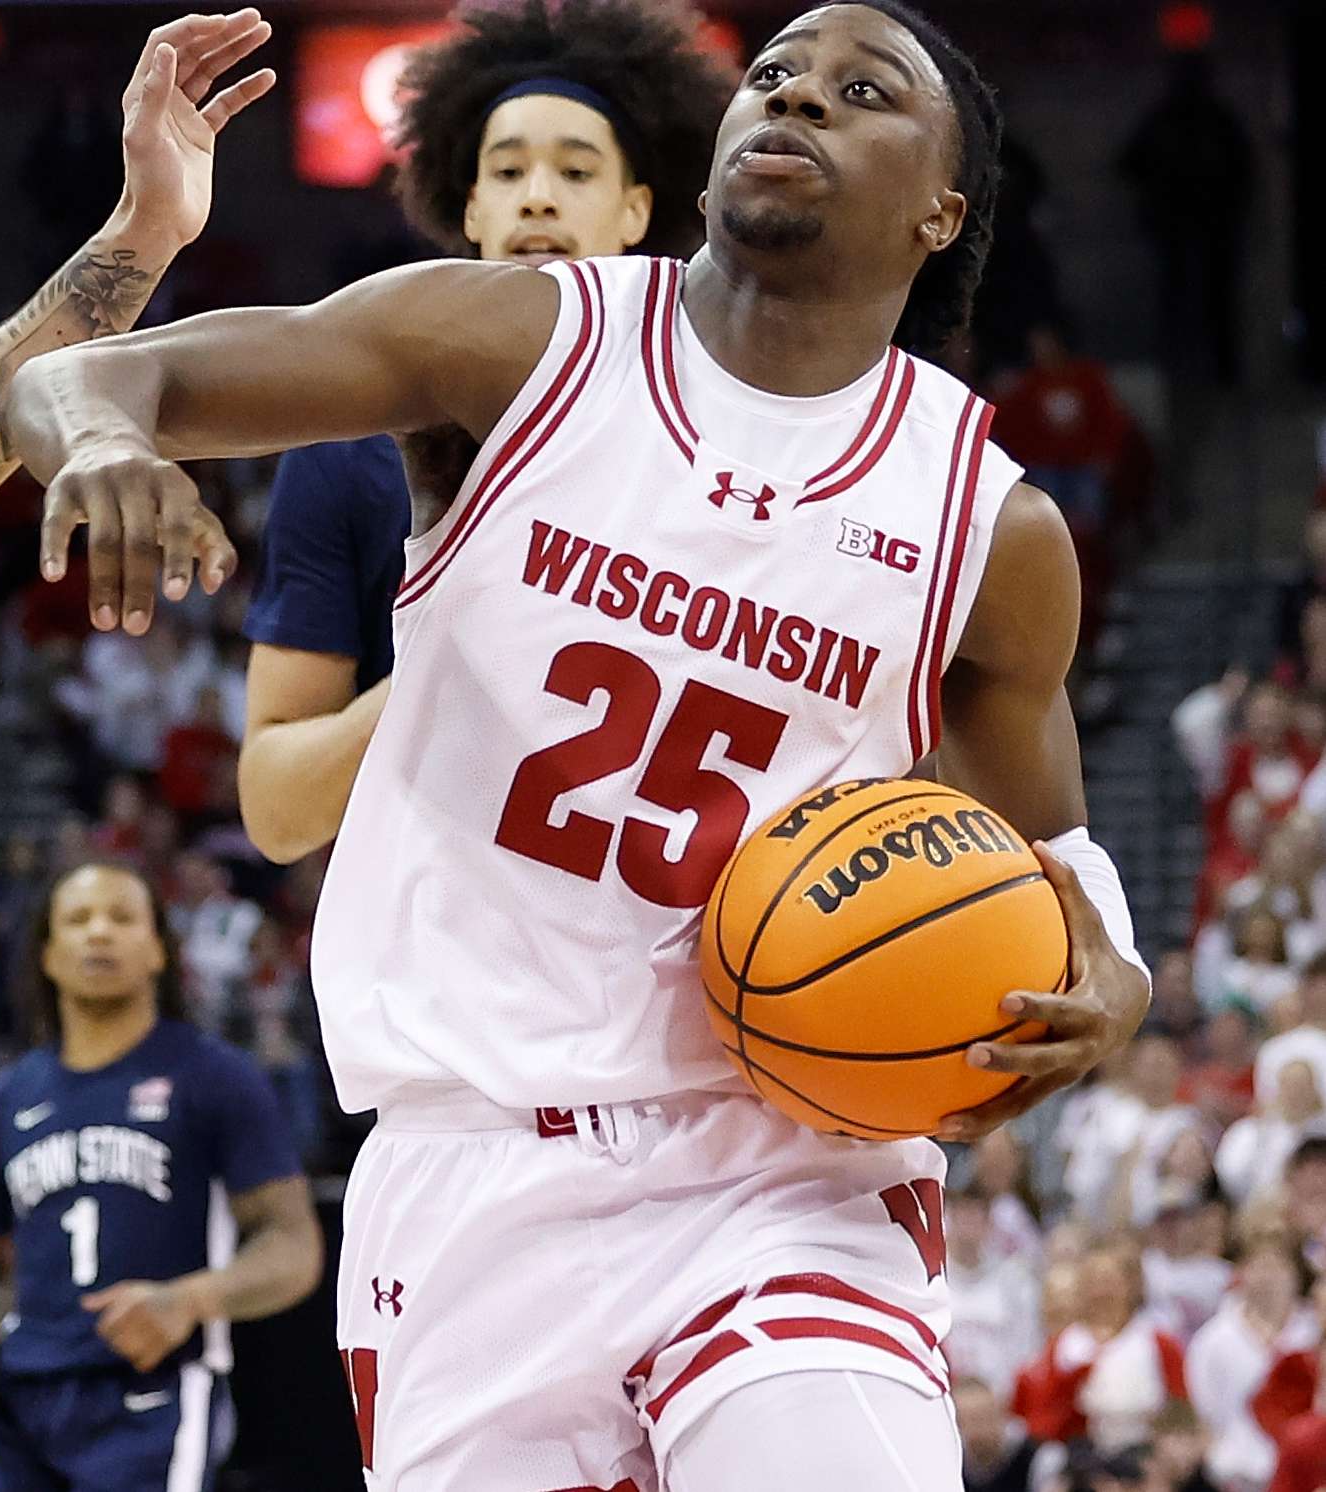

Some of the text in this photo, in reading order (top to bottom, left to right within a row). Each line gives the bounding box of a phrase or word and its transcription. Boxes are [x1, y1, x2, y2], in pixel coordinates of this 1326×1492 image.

[522, 520, 880, 709] WISCONSIN
[494, 640, 789, 908] 25
[803, 810, 1022, 914] Wilson
[60, 1195, 100, 1286] 1
